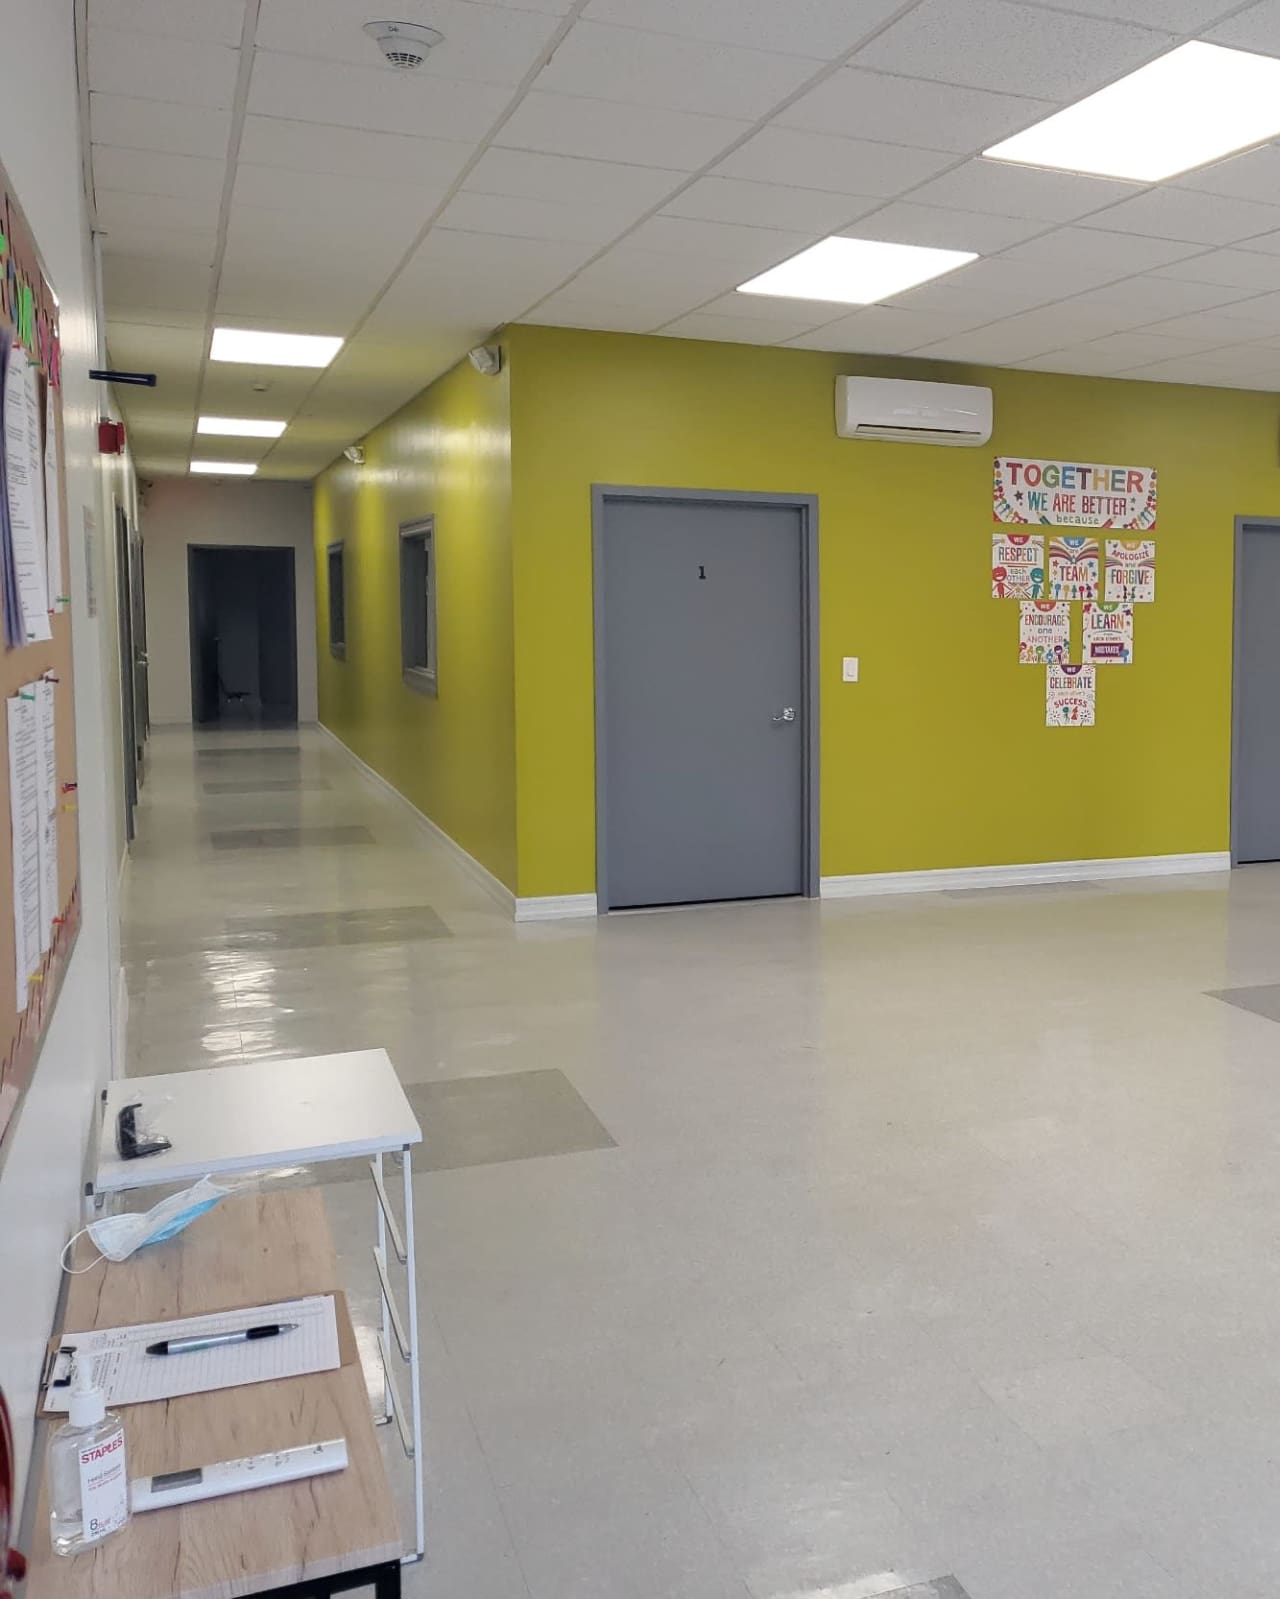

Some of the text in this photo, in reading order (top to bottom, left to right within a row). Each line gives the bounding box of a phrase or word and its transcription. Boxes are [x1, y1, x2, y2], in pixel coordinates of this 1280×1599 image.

[1006, 462, 1144, 493] TOGETHER
[1027, 491, 1127, 516] WE ARE BETTER
[1056, 514, 1100, 525] because
[998, 546, 1039, 562] RESPECT
[1111, 549, 1150, 561] APOLOGIZE
[698, 566, 706, 580] 1
[1059, 565, 1088, 582] TEAM
[1111, 569, 1150, 585] FORGIVE
[1024, 614, 1066, 626] ENCOURAGE
[1091, 614, 1125, 630] LEARN
[1026, 635, 1063, 643] ANOTHER
[1049, 676, 1093, 689] CELEBRATE
[1054, 697, 1088, 709] SUCCESS
[80, 1436, 124, 1465] STAPLES
